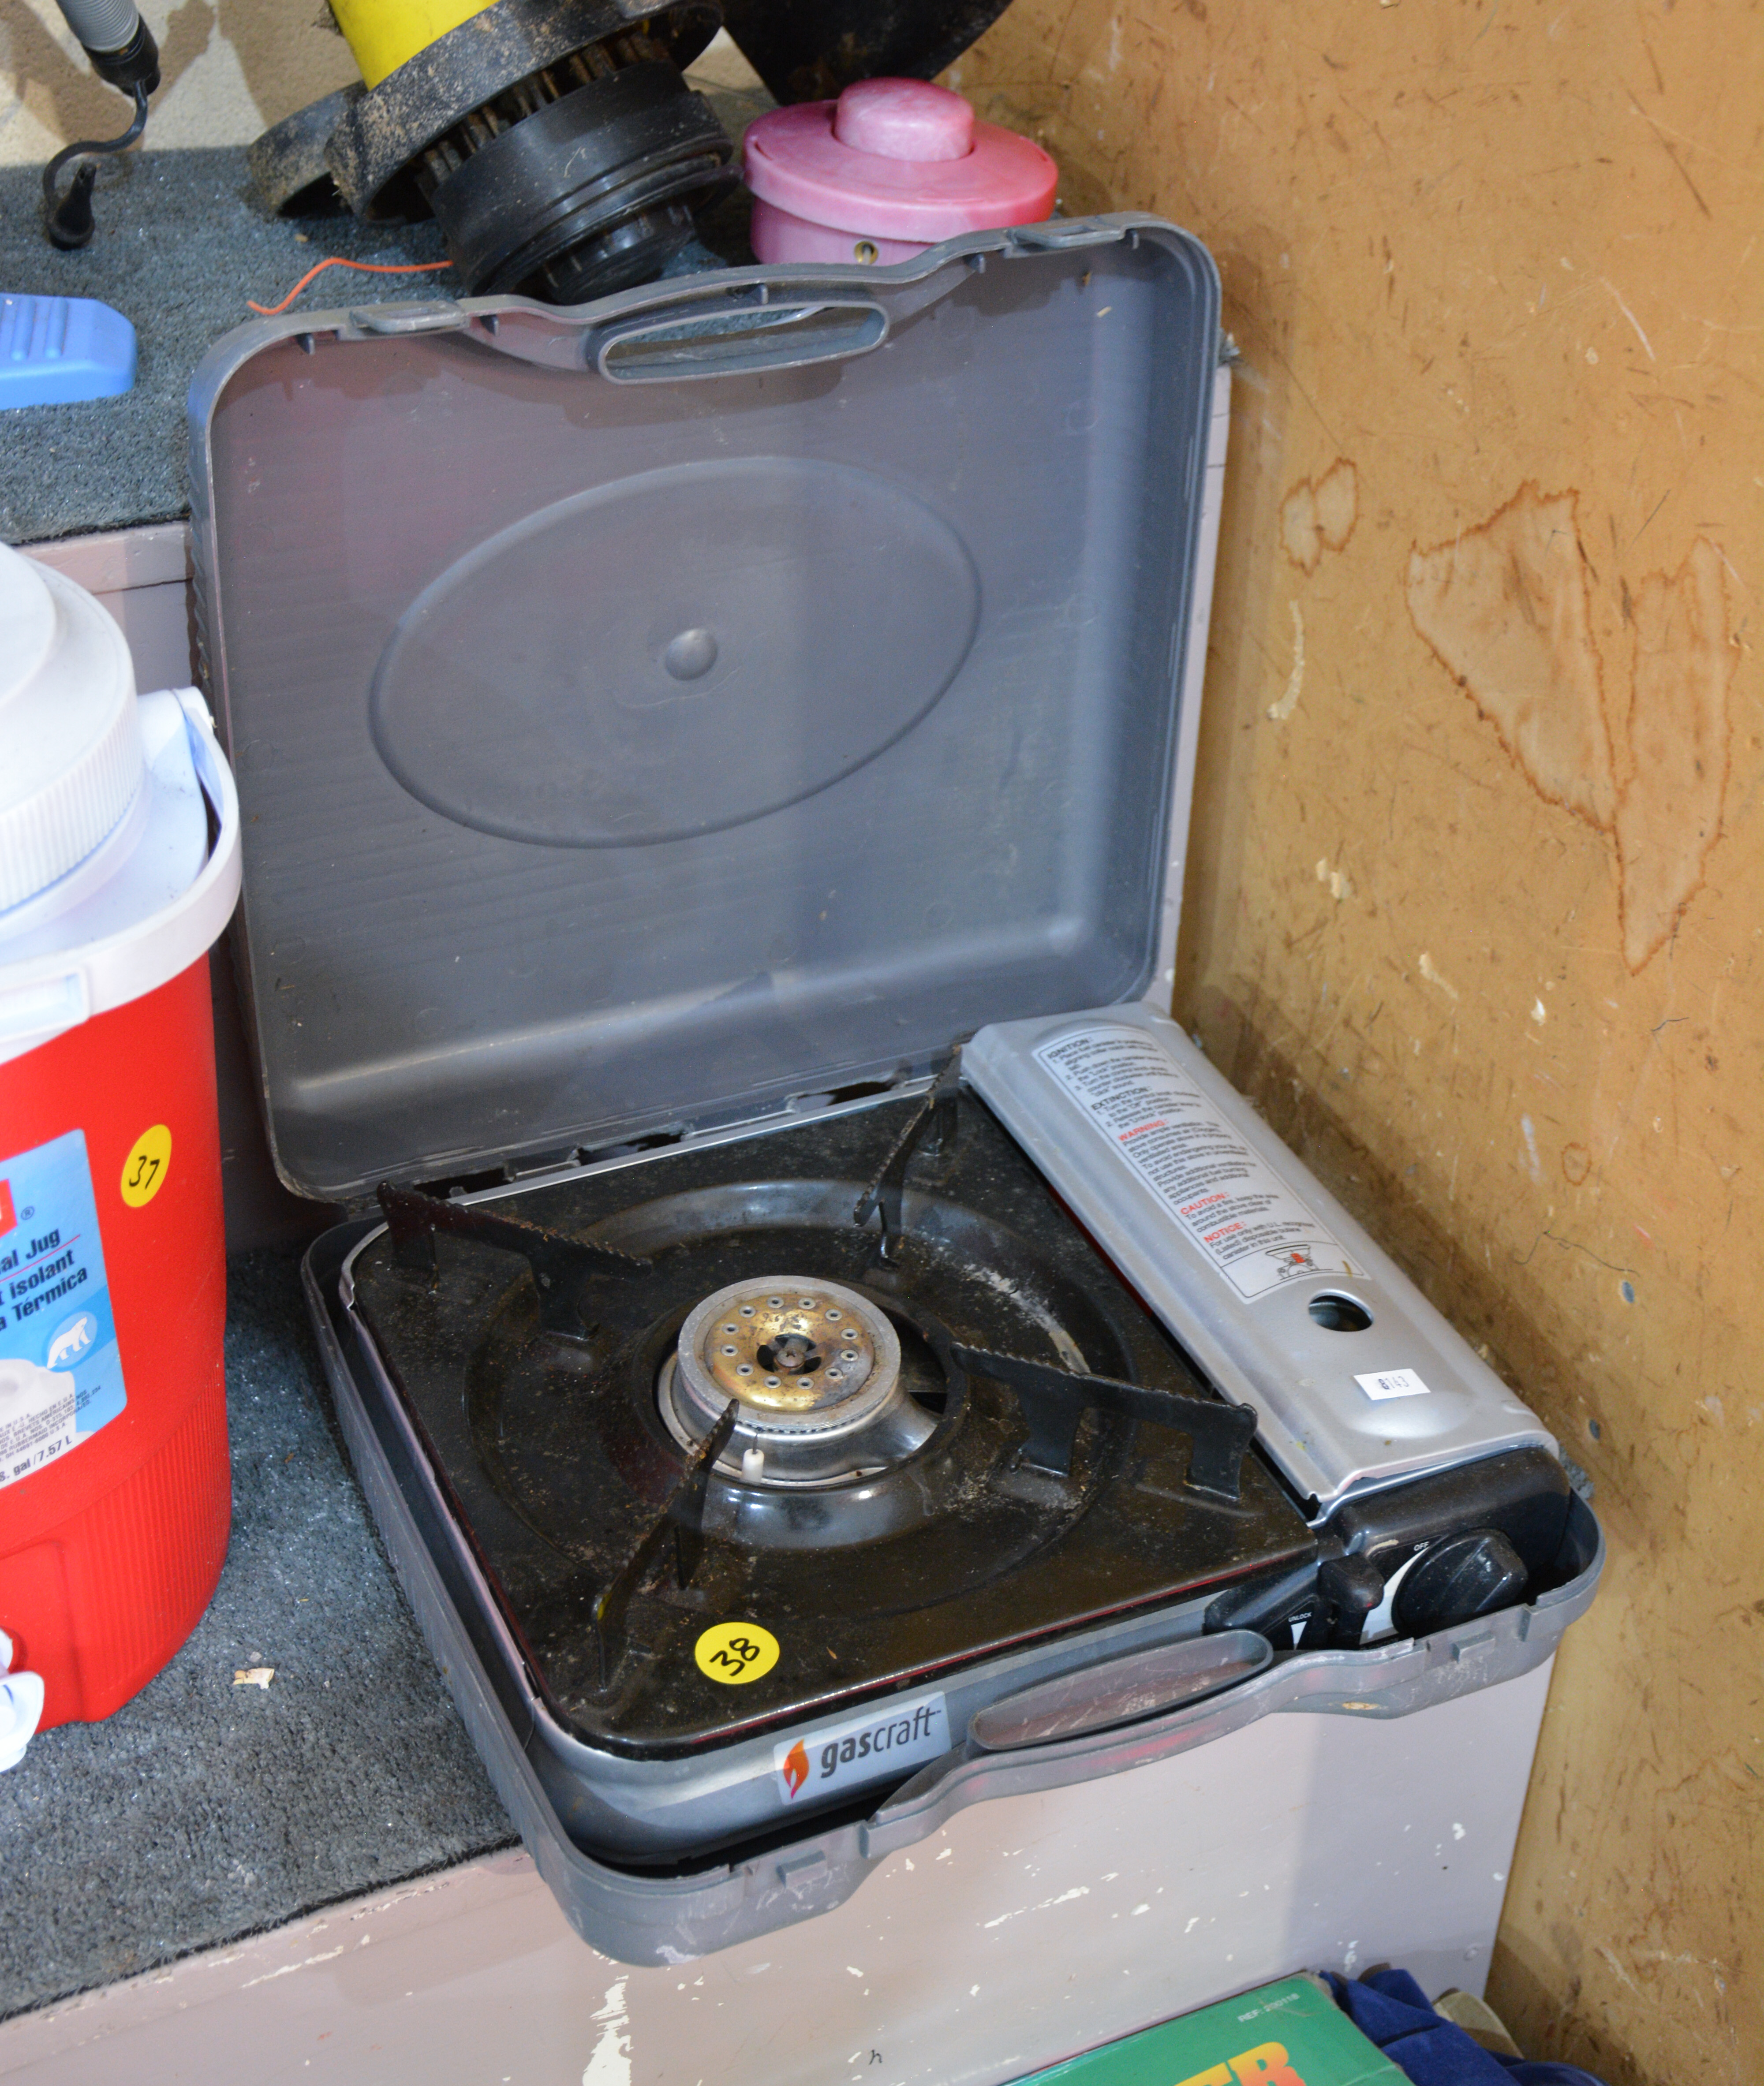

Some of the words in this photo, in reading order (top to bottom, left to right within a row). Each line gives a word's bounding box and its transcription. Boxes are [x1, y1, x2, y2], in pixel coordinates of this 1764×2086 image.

[1047, 1039, 1089, 1059] IGNITION:
[1091, 1087, 1149, 1111] EXTINCTION:
[129, 1155, 160, 1190] 37
[1180, 1193, 1226, 1215] CAUTION:
[1203, 1222, 1246, 1243] NOTICE:
[1209, 1239, 1223, 1248] For
[1223, 1234, 1237, 1242] use
[26, 1228, 61, 1260] Jug
[1222, 1245, 1250, 1260] canister
[9, 1249, 75, 1299] isolant
[11, 1267, 88, 1321] Térmica
[28, 1409, 48, 1423] HECHO
[49, 1403, 57, 1412] EN
[9, 1427, 48, 1451] RUBBERMAID
[14, 1419, 40, 1437] BREVETS
[1413, 1541, 1429, 1551] OFF
[1288, 1612, 1312, 1622] UNLOCK
[709, 1638, 760, 1676] 38
[821, 1705, 937, 1779] gascraft
